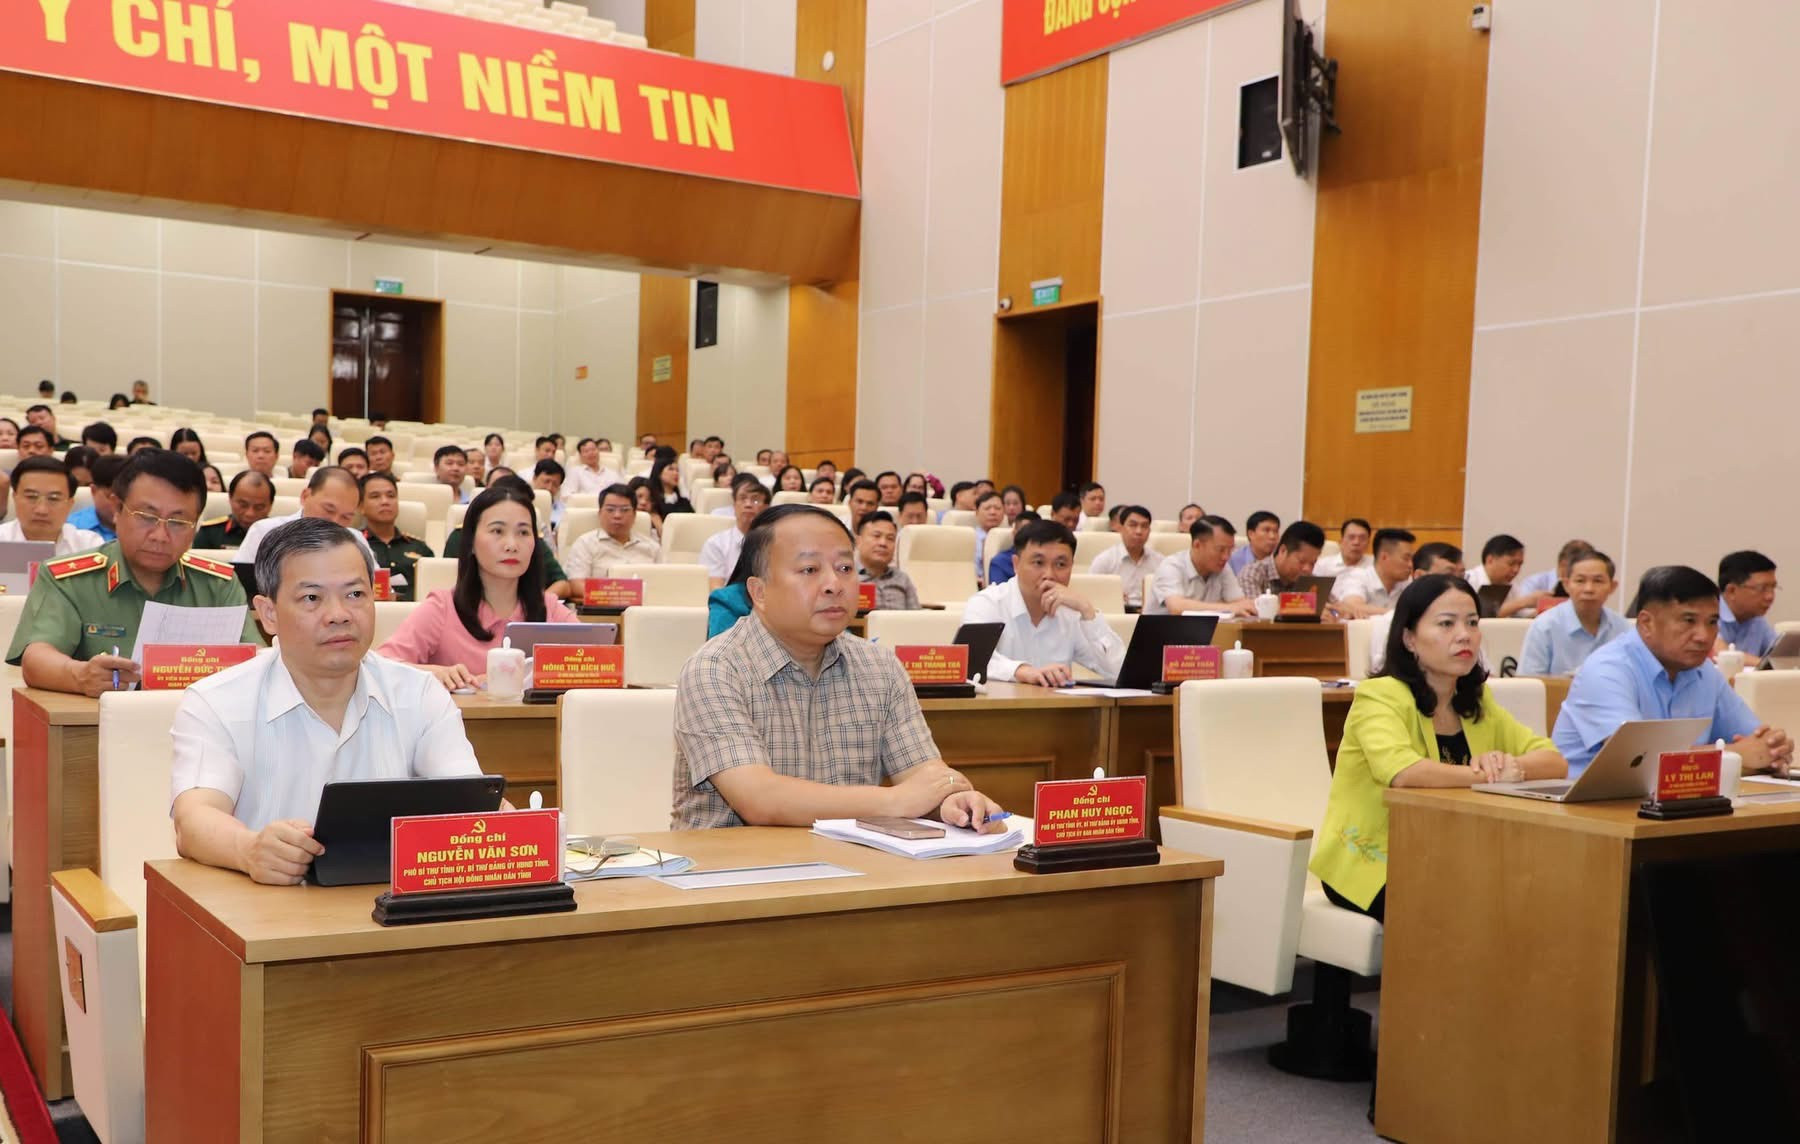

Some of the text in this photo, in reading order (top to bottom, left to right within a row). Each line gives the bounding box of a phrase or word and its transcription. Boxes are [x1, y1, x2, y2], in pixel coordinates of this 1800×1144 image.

[288, 22, 433, 110] MỘT
[458, 49, 622, 134] NIỀM
[638, 84, 735, 152] TIN
[152, 664, 191, 674] NGUYỄN
[1049, 805, 1133, 820] PHAN HUY NGỌC
[486, 832, 506, 842] chí
[417, 844, 538, 863] NGUYỄN VĂN SƠN
[403, 867, 417, 877] PHÓ
[418, 866, 425, 875] BÍ
[426, 865, 440, 875] THƯ
[468, 863, 475, 873] BÍ
[476, 863, 488, 872] THƯ
[424, 876, 437, 886] CHỦ
[439, 877, 453, 886] TỊCH
